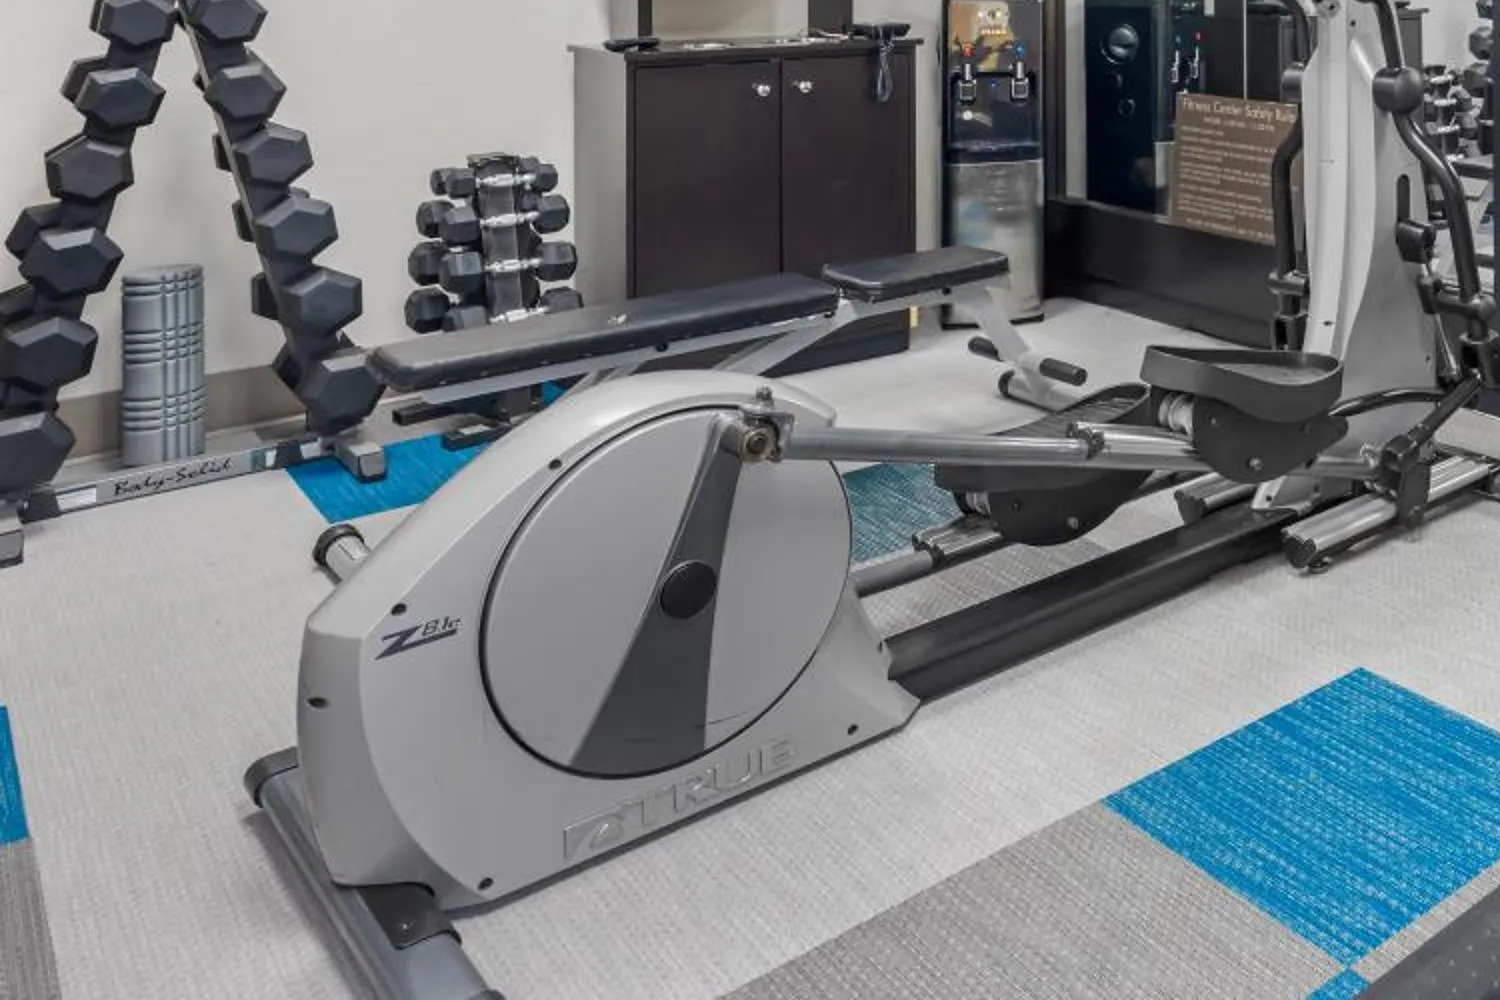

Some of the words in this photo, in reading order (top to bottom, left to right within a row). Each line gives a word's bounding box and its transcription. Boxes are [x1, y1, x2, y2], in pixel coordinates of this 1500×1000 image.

[1183, 98, 1211, 113] Fitness
[1213, 101, 1240, 115] Center
[1245, 104, 1274, 122] Safety
[114, 456, 234, 496] Body-Solid
[624, 738, 795, 827] TRUE
